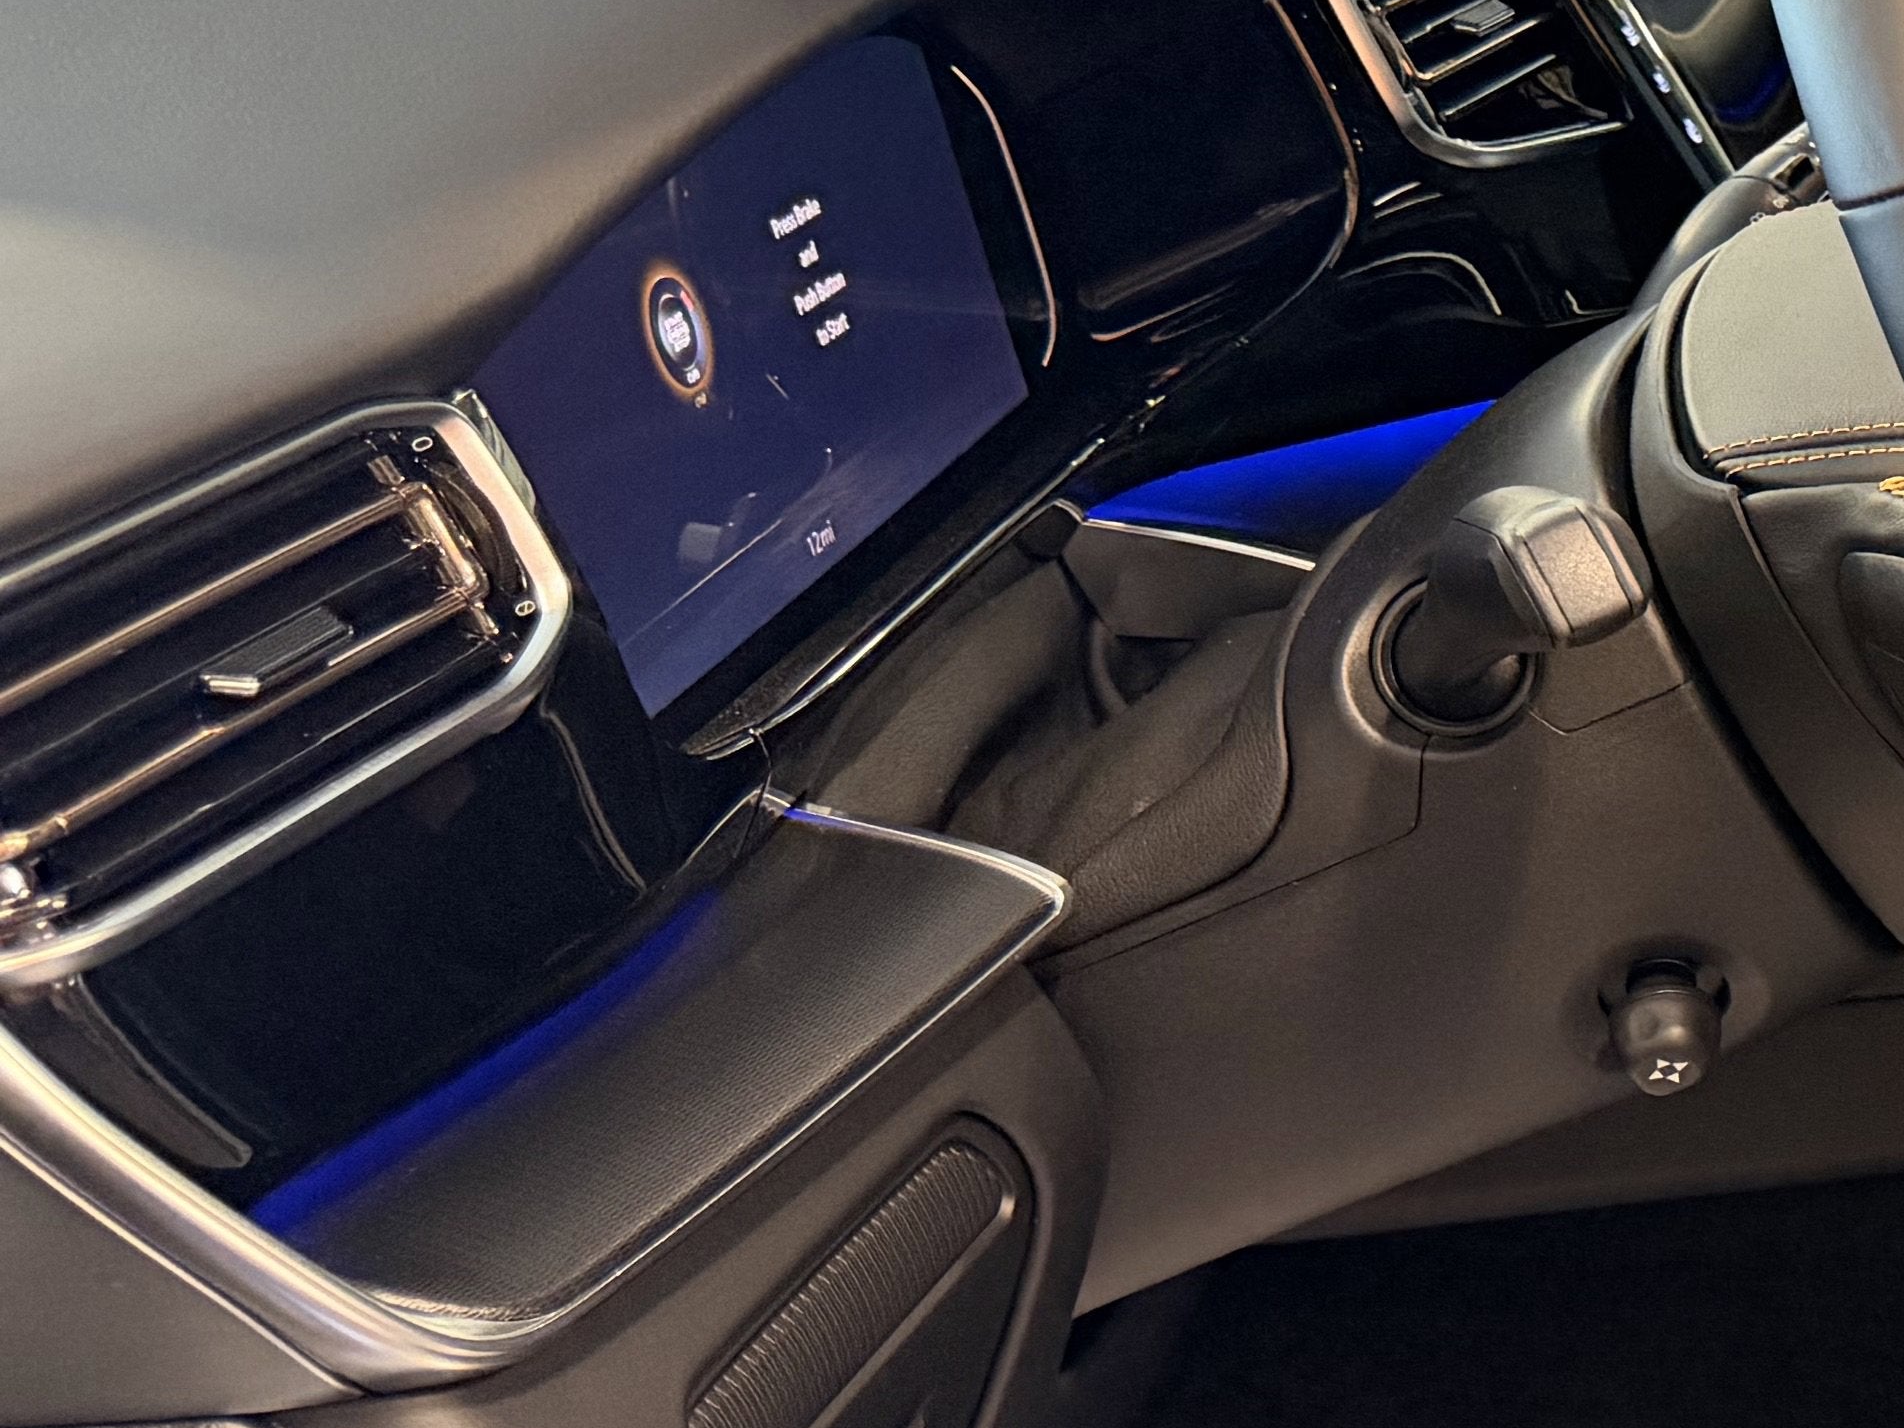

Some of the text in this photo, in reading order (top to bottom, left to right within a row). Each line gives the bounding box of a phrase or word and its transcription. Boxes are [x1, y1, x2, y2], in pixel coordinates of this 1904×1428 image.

[769, 198, 822, 240] Press Brake
[793, 272, 847, 317] Push Button
[824, 312, 851, 341] Start
